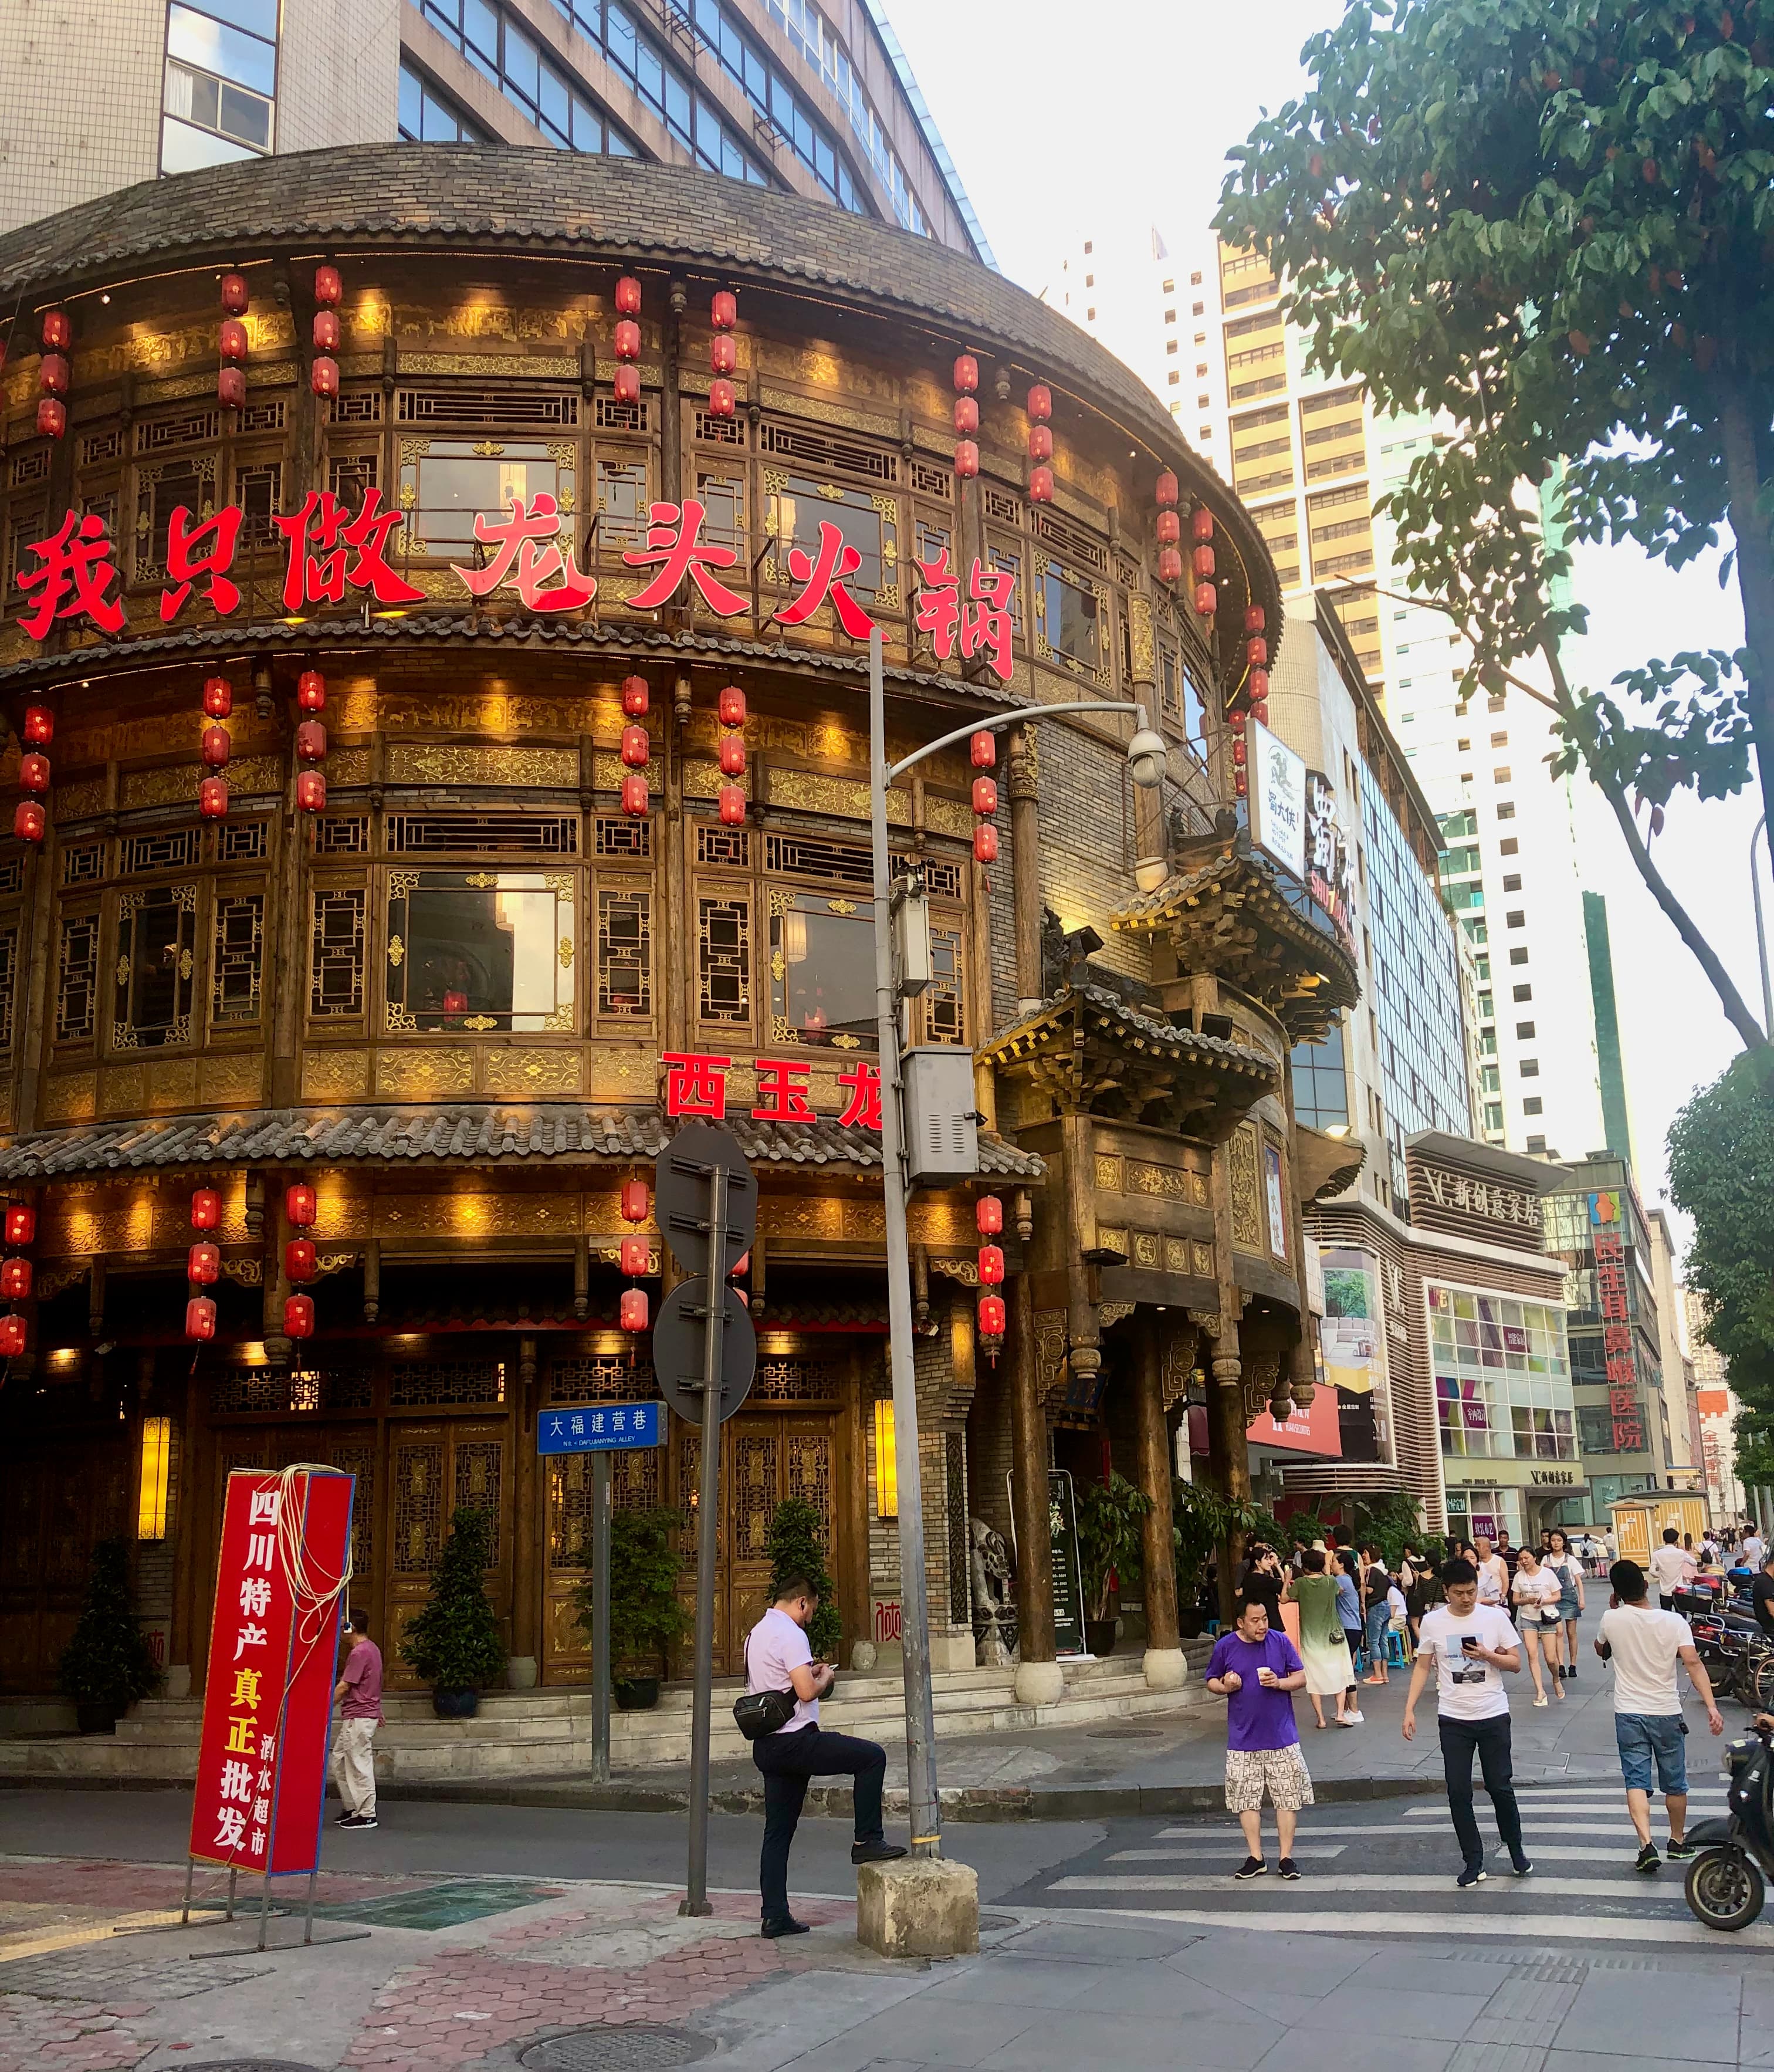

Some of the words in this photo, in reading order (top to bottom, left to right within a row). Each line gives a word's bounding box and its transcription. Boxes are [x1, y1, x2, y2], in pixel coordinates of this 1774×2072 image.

[16, 486, 1015, 681] 我只做龙头火锅
[1268, 788, 1296, 833] 蜀大侠
[1267, 1151, 1282, 1251] 蜀大侠
[1453, 1175, 1539, 1226] 新创意家居
[1593, 1232, 1643, 1450] 民生耳鼻喉医院
[550, 1409, 647, 1437] 大福建营巷
[213, 1489, 280, 1852] 四川特产真正批发
[250, 1733, 276, 1855] 酒水超市
